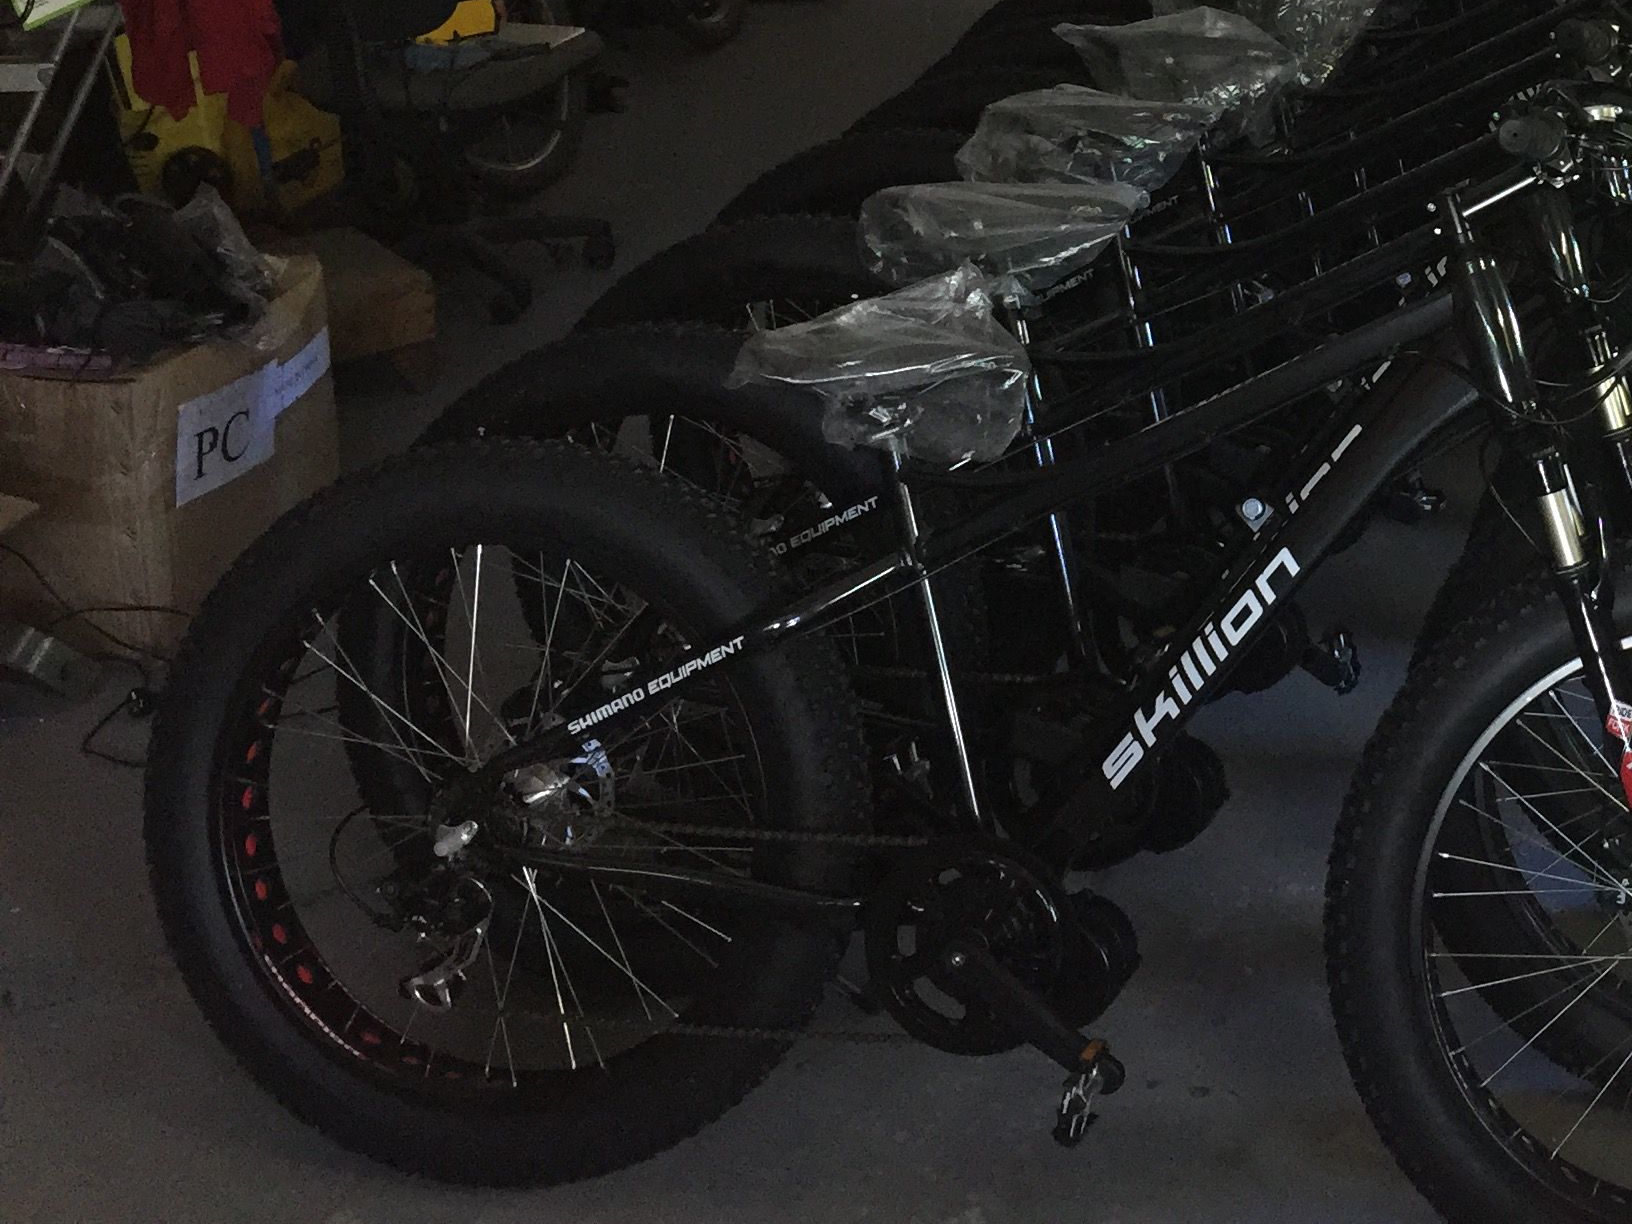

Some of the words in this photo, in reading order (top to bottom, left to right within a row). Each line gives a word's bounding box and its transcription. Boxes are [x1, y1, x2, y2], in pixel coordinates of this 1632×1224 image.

[193, 408, 250, 481] PC
[789, 495, 879, 549] EQUIPMENT
[567, 687, 646, 736] SHIMANO
[647, 635, 745, 696] EQUIPMENT
[1101, 545, 1301, 791] skillion
